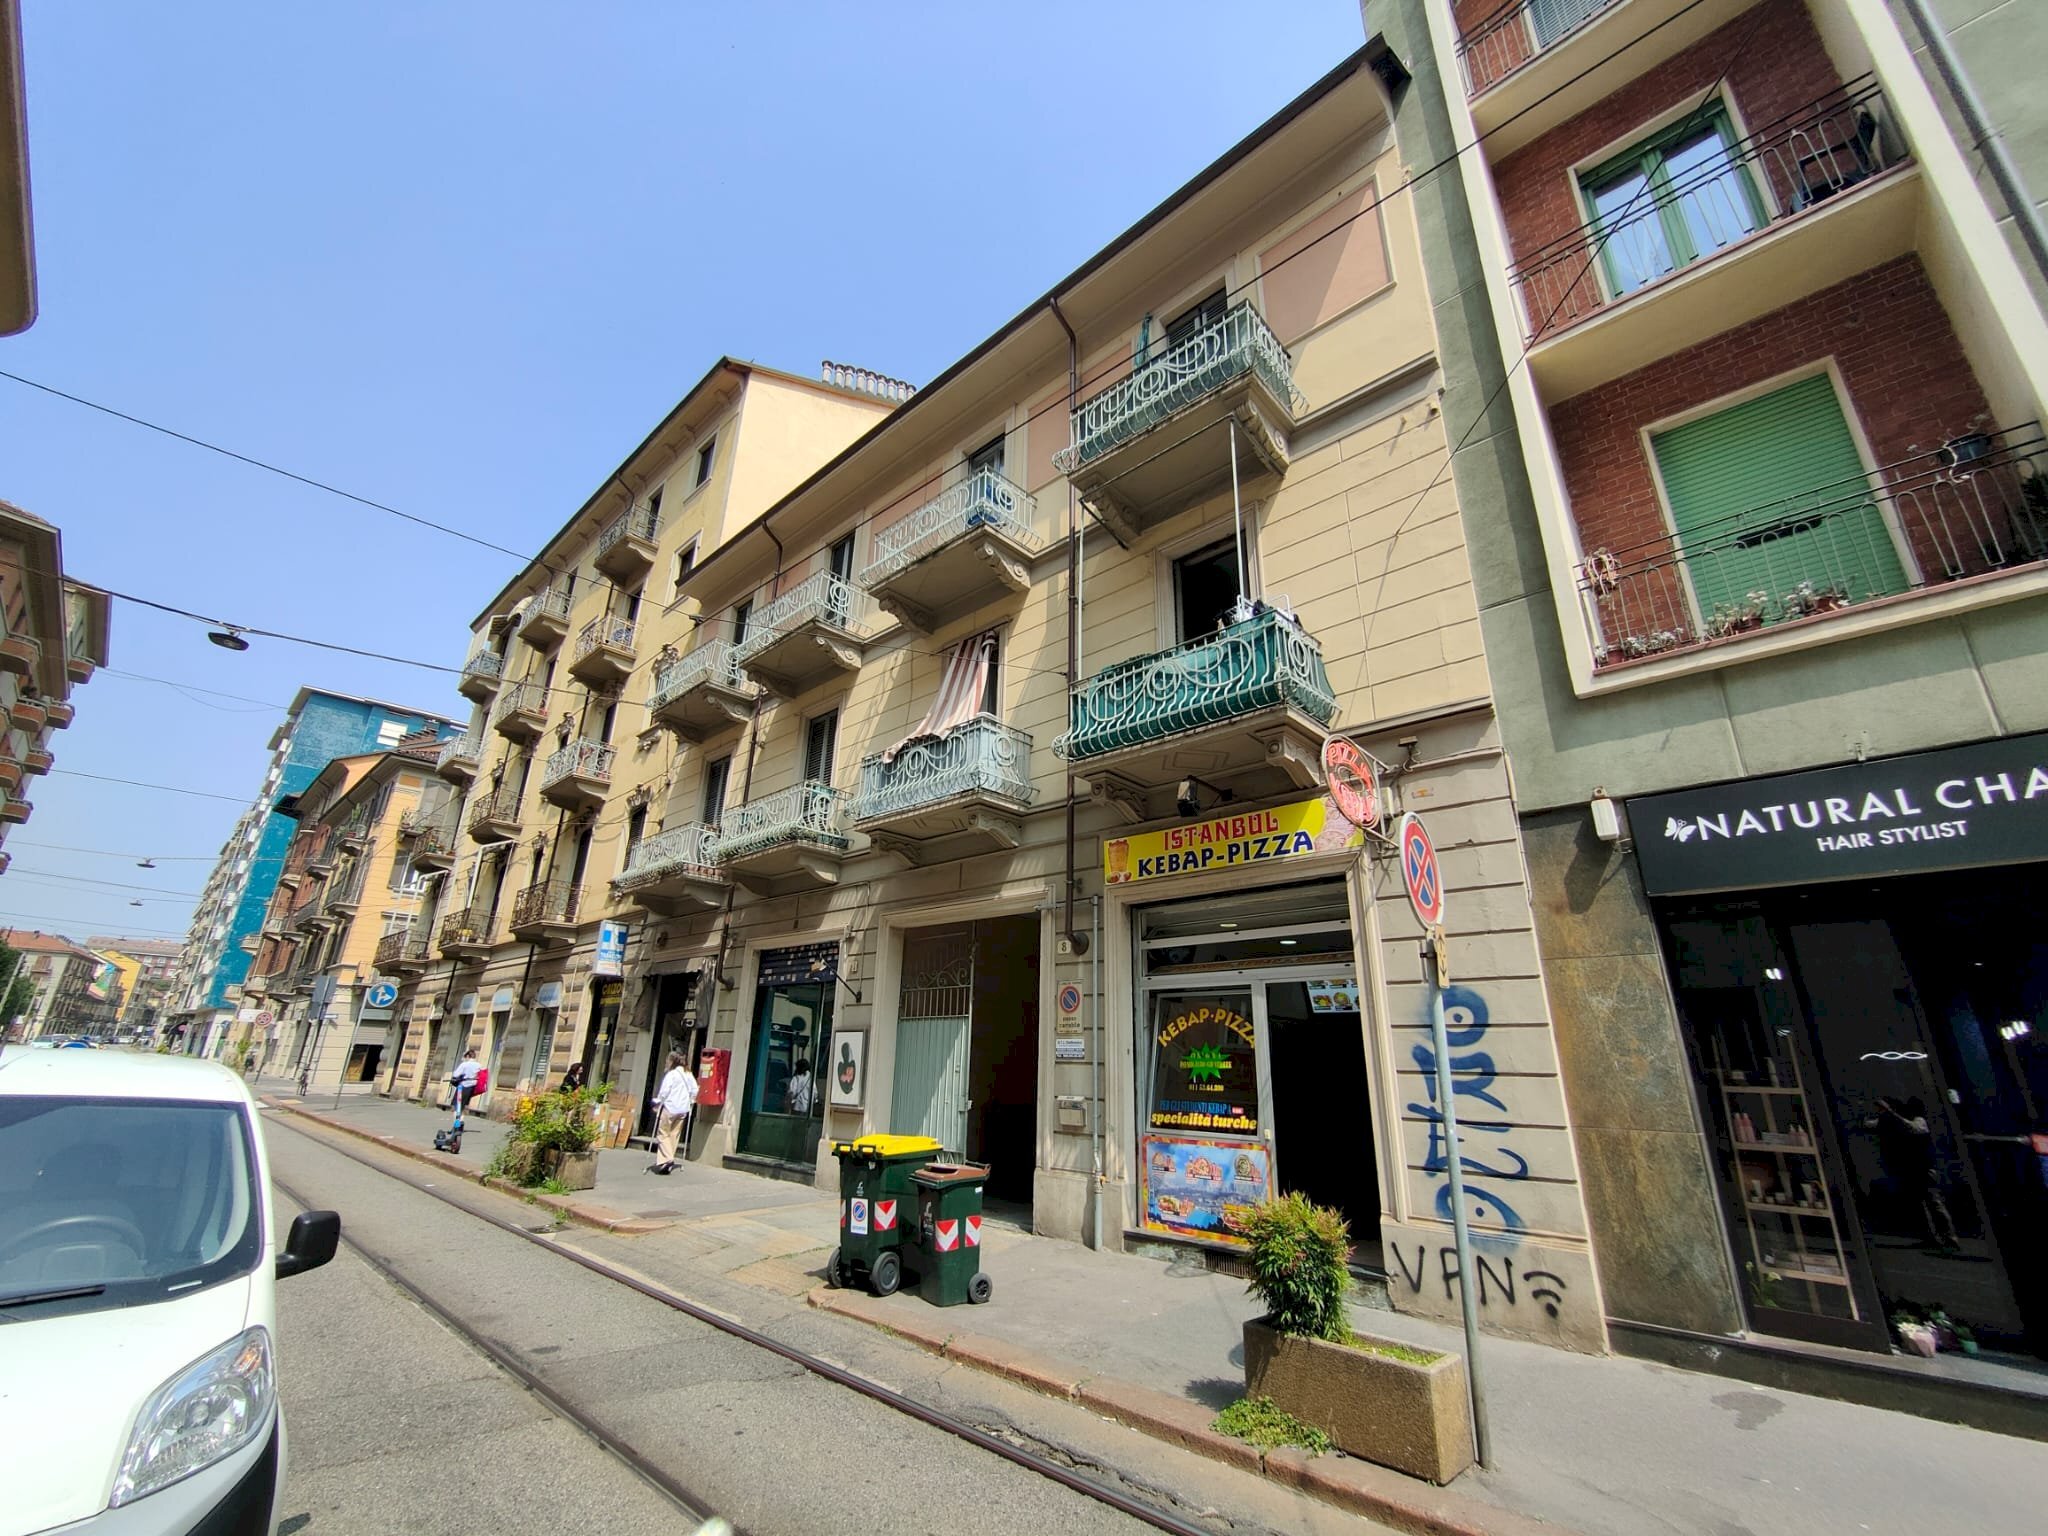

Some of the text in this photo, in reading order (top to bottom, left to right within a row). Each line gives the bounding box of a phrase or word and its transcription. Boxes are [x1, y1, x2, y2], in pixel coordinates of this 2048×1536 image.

[1164, 811, 1279, 850] ISTANBUL
[1696, 788, 1921, 841] NATURAL
[1817, 820, 1967, 852] HAIR STYLIST
[1138, 831, 1313, 877] KEBAP-PIZZA
[1061, 941, 1067, 953] 8
[1212, 1115, 1257, 1129] turche
